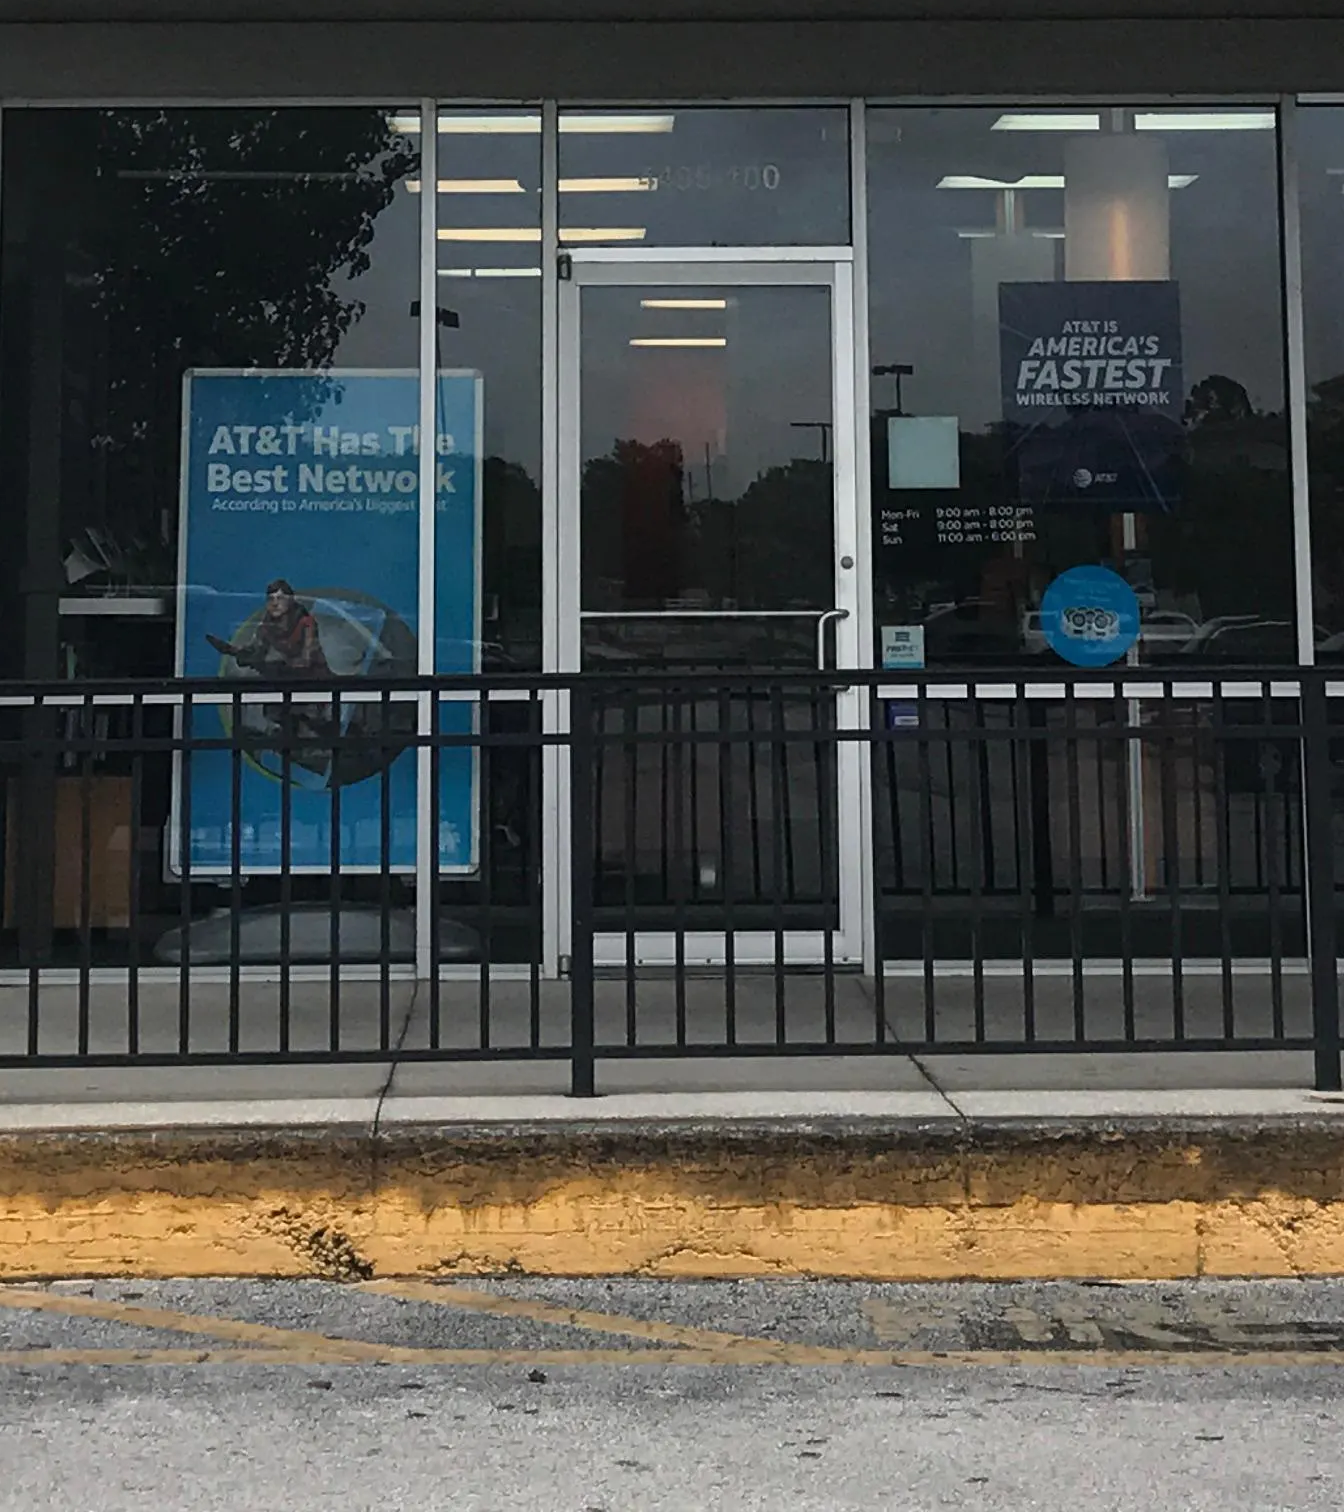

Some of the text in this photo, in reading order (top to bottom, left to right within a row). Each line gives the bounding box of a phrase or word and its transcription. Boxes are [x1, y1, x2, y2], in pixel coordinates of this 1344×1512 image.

[1063, 320, 1118, 334] AT&T IS
[1028, 335, 1159, 357] AMERICA'S
[1017, 358, 1172, 390] FASTEST
[1017, 391, 1170, 405] WIRELESS NETWORK
[208, 425, 304, 456] AT&T
[313, 425, 381, 456] Has
[207, 463, 456, 493] Best Netwok
[211, 497, 279, 514] According
[282, 498, 297, 511] to
[298, 498, 362, 511] America's
[881, 508, 920, 520] Mon-Fri
[963, 508, 980, 517] am
[1015, 507, 1034, 518] pm
[964, 521, 981, 530] am
[1016, 520, 1034, 530] pm
[965, 534, 983, 542] am
[1018, 532, 1037, 542] pm
